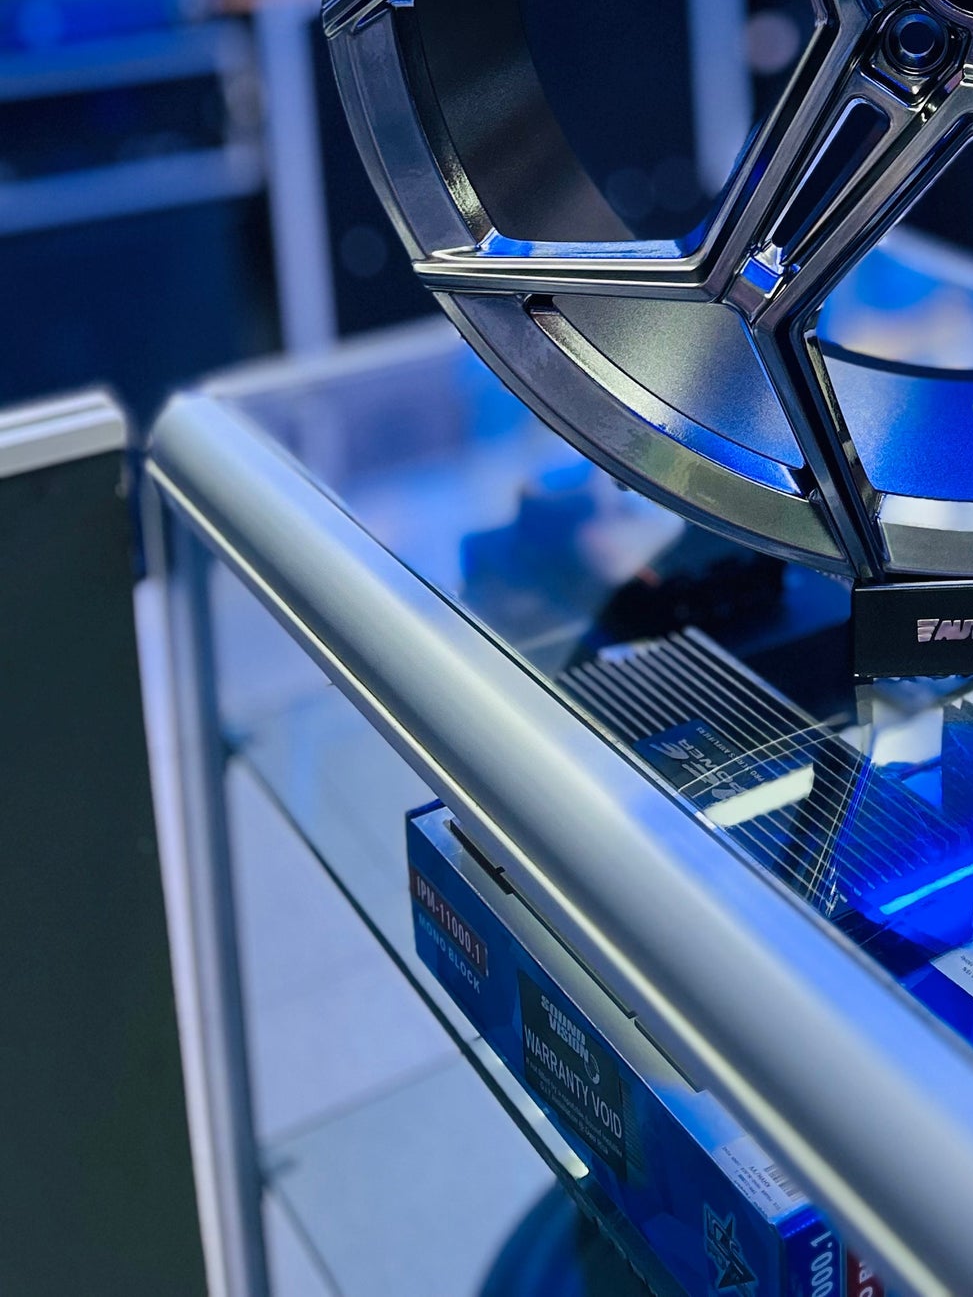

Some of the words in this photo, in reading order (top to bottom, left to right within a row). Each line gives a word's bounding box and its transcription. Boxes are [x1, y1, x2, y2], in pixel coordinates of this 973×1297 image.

[416, 875, 480, 964] IPM-11000.1
[418, 912, 447, 952] MONO
[448, 947, 480, 994] BLOCK
[549, 1013, 589, 1063] VISION
[524, 1024, 589, 1106] WARRANTY
[591, 1086, 622, 1139] VOID
